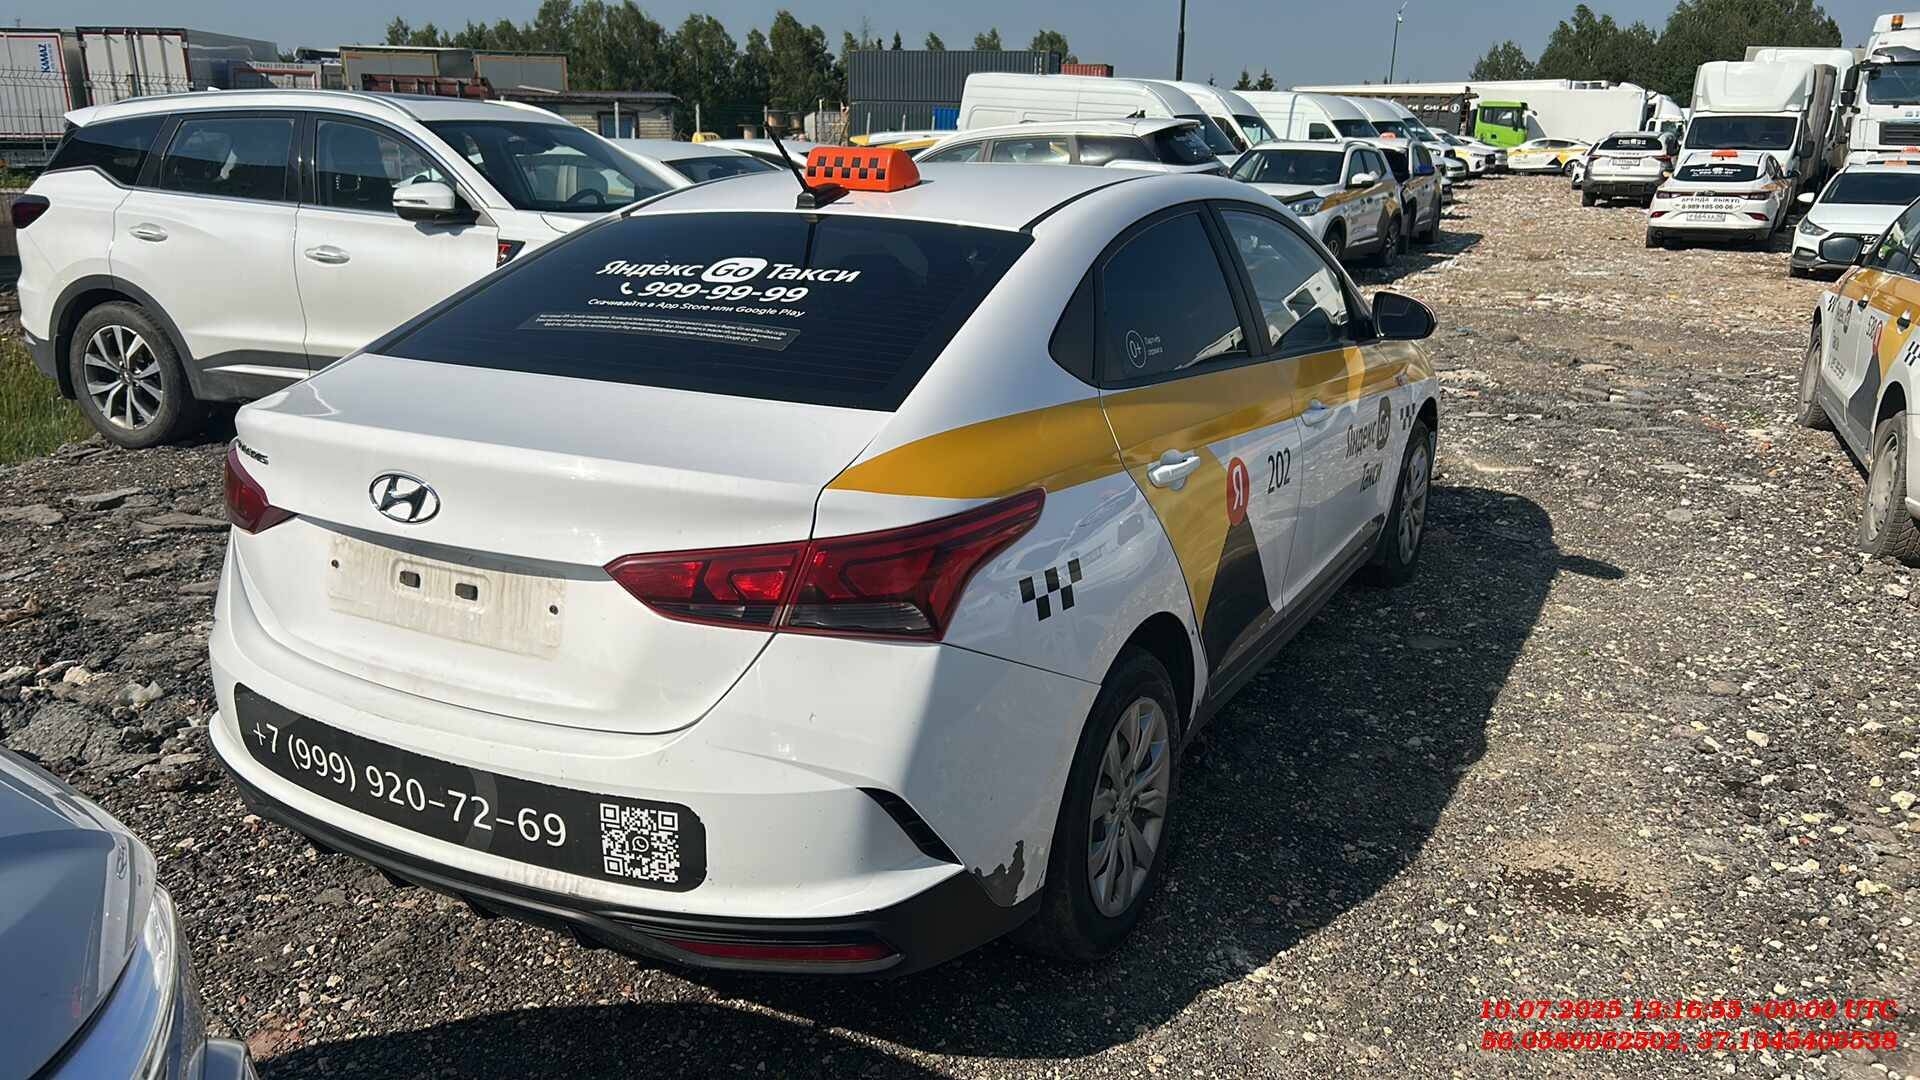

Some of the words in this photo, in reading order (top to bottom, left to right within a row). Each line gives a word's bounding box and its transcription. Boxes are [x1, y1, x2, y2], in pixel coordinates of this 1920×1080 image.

[596, 260, 704, 278] Яндекс
[766, 263, 862, 283] Такси
[637, 281, 809, 303] 999-99-99
[656, 302, 680, 311] App
[679, 303, 710, 311] Store
[711, 305, 735, 313] или
[735, 306, 778, 316] Google
[778, 308, 806, 318] Play
[1267, 447, 1291, 495] 202
[252, 721, 279, 754] +7
[288, 733, 357, 793] (999)
[365, 765, 568, 847] 920-72-69
